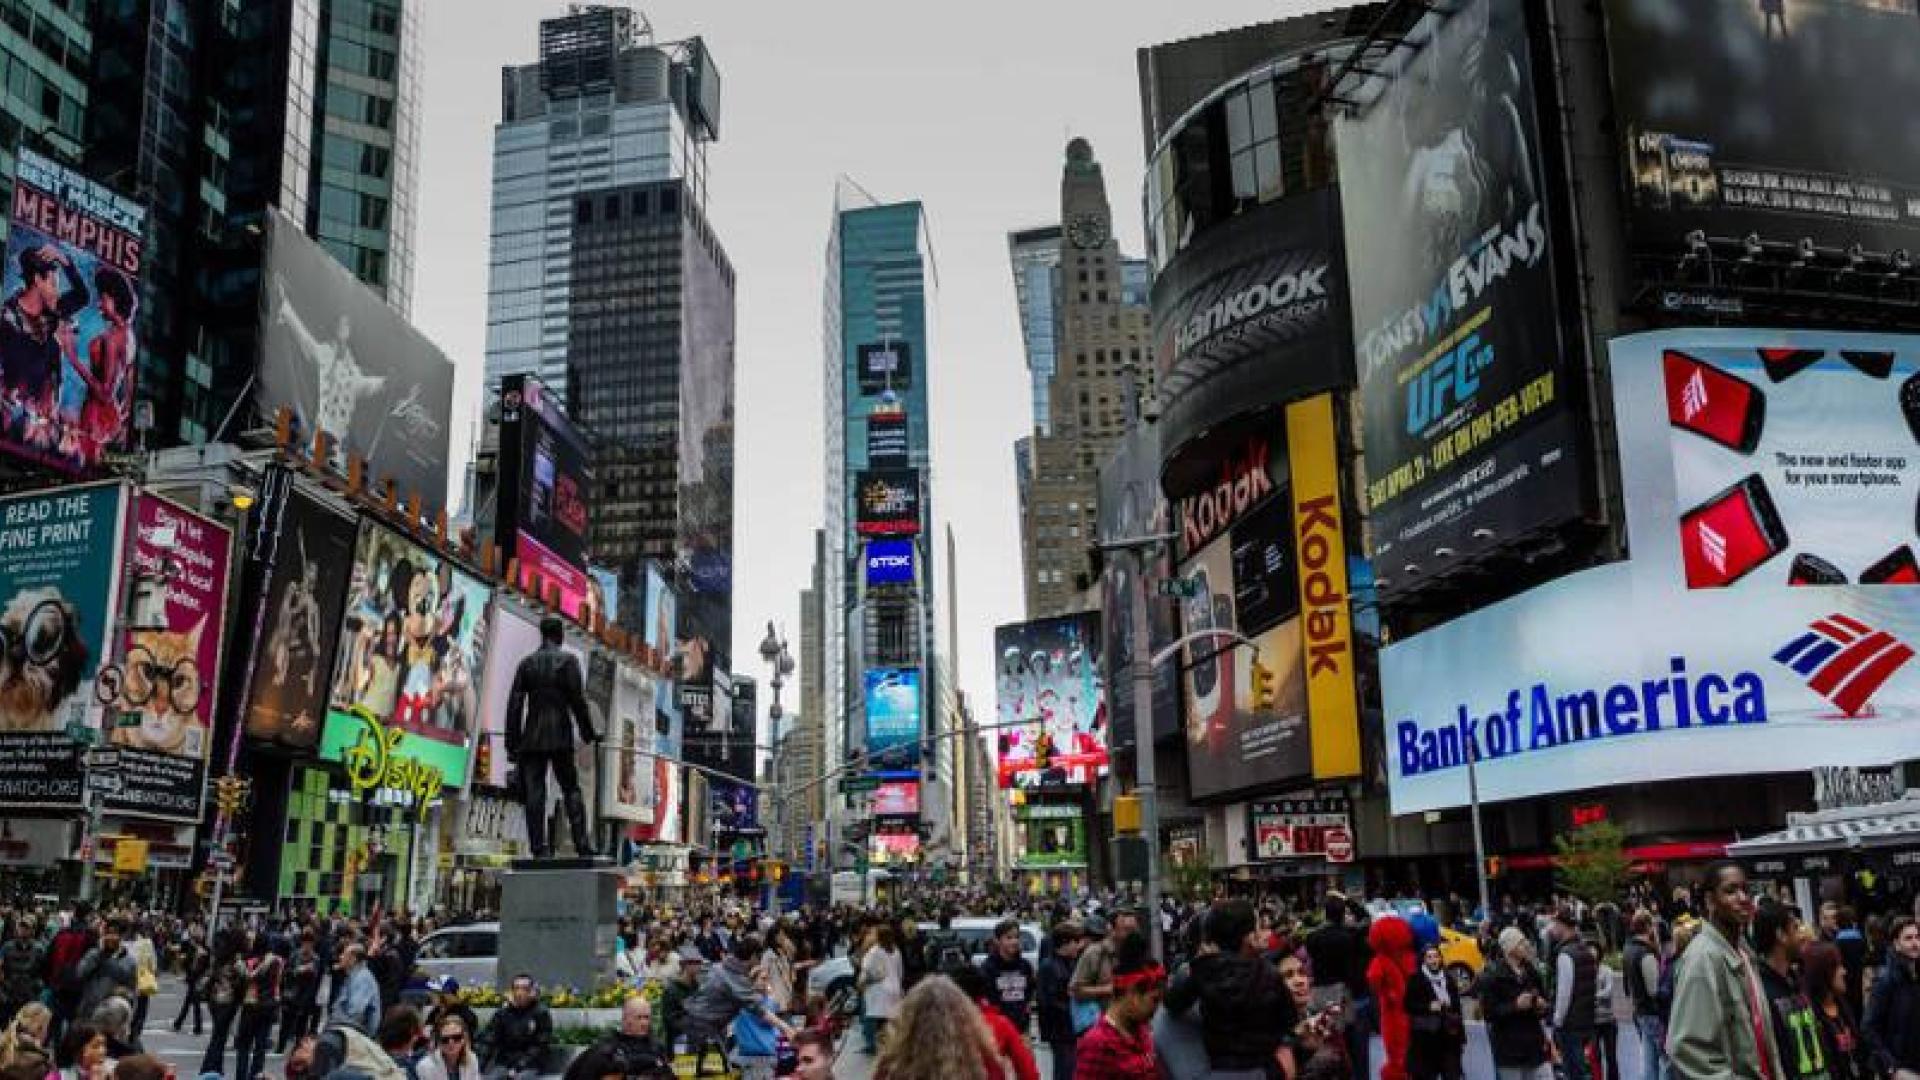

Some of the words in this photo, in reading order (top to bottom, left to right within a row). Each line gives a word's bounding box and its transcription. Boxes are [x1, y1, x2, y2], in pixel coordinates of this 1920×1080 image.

[14, 186, 140, 272] MEMPHIS
[1449, 202, 1545, 309] EVANS
[1406, 333, 1481, 435] UFC
[1774, 452, 1797, 466] The
[1799, 456, 1824, 466] new
[1827, 453, 1848, 466] and
[1850, 453, 1882, 467] faster
[1885, 457, 1906, 471] app
[1785, 469, 1801, 484] for
[1804, 474, 1828, 487] your
[6, 500, 50, 525] READ
[56, 495, 90, 518] THE
[41, 520, 92, 544] PRINT
[1181, 462, 1273, 554] Kodak
[1298, 495, 1346, 678] Kodak
[1396, 704, 1480, 776] Bank
[1483, 690, 1521, 758] of
[1530, 656, 1768, 750] America
[345, 703, 443, 823] Disney
